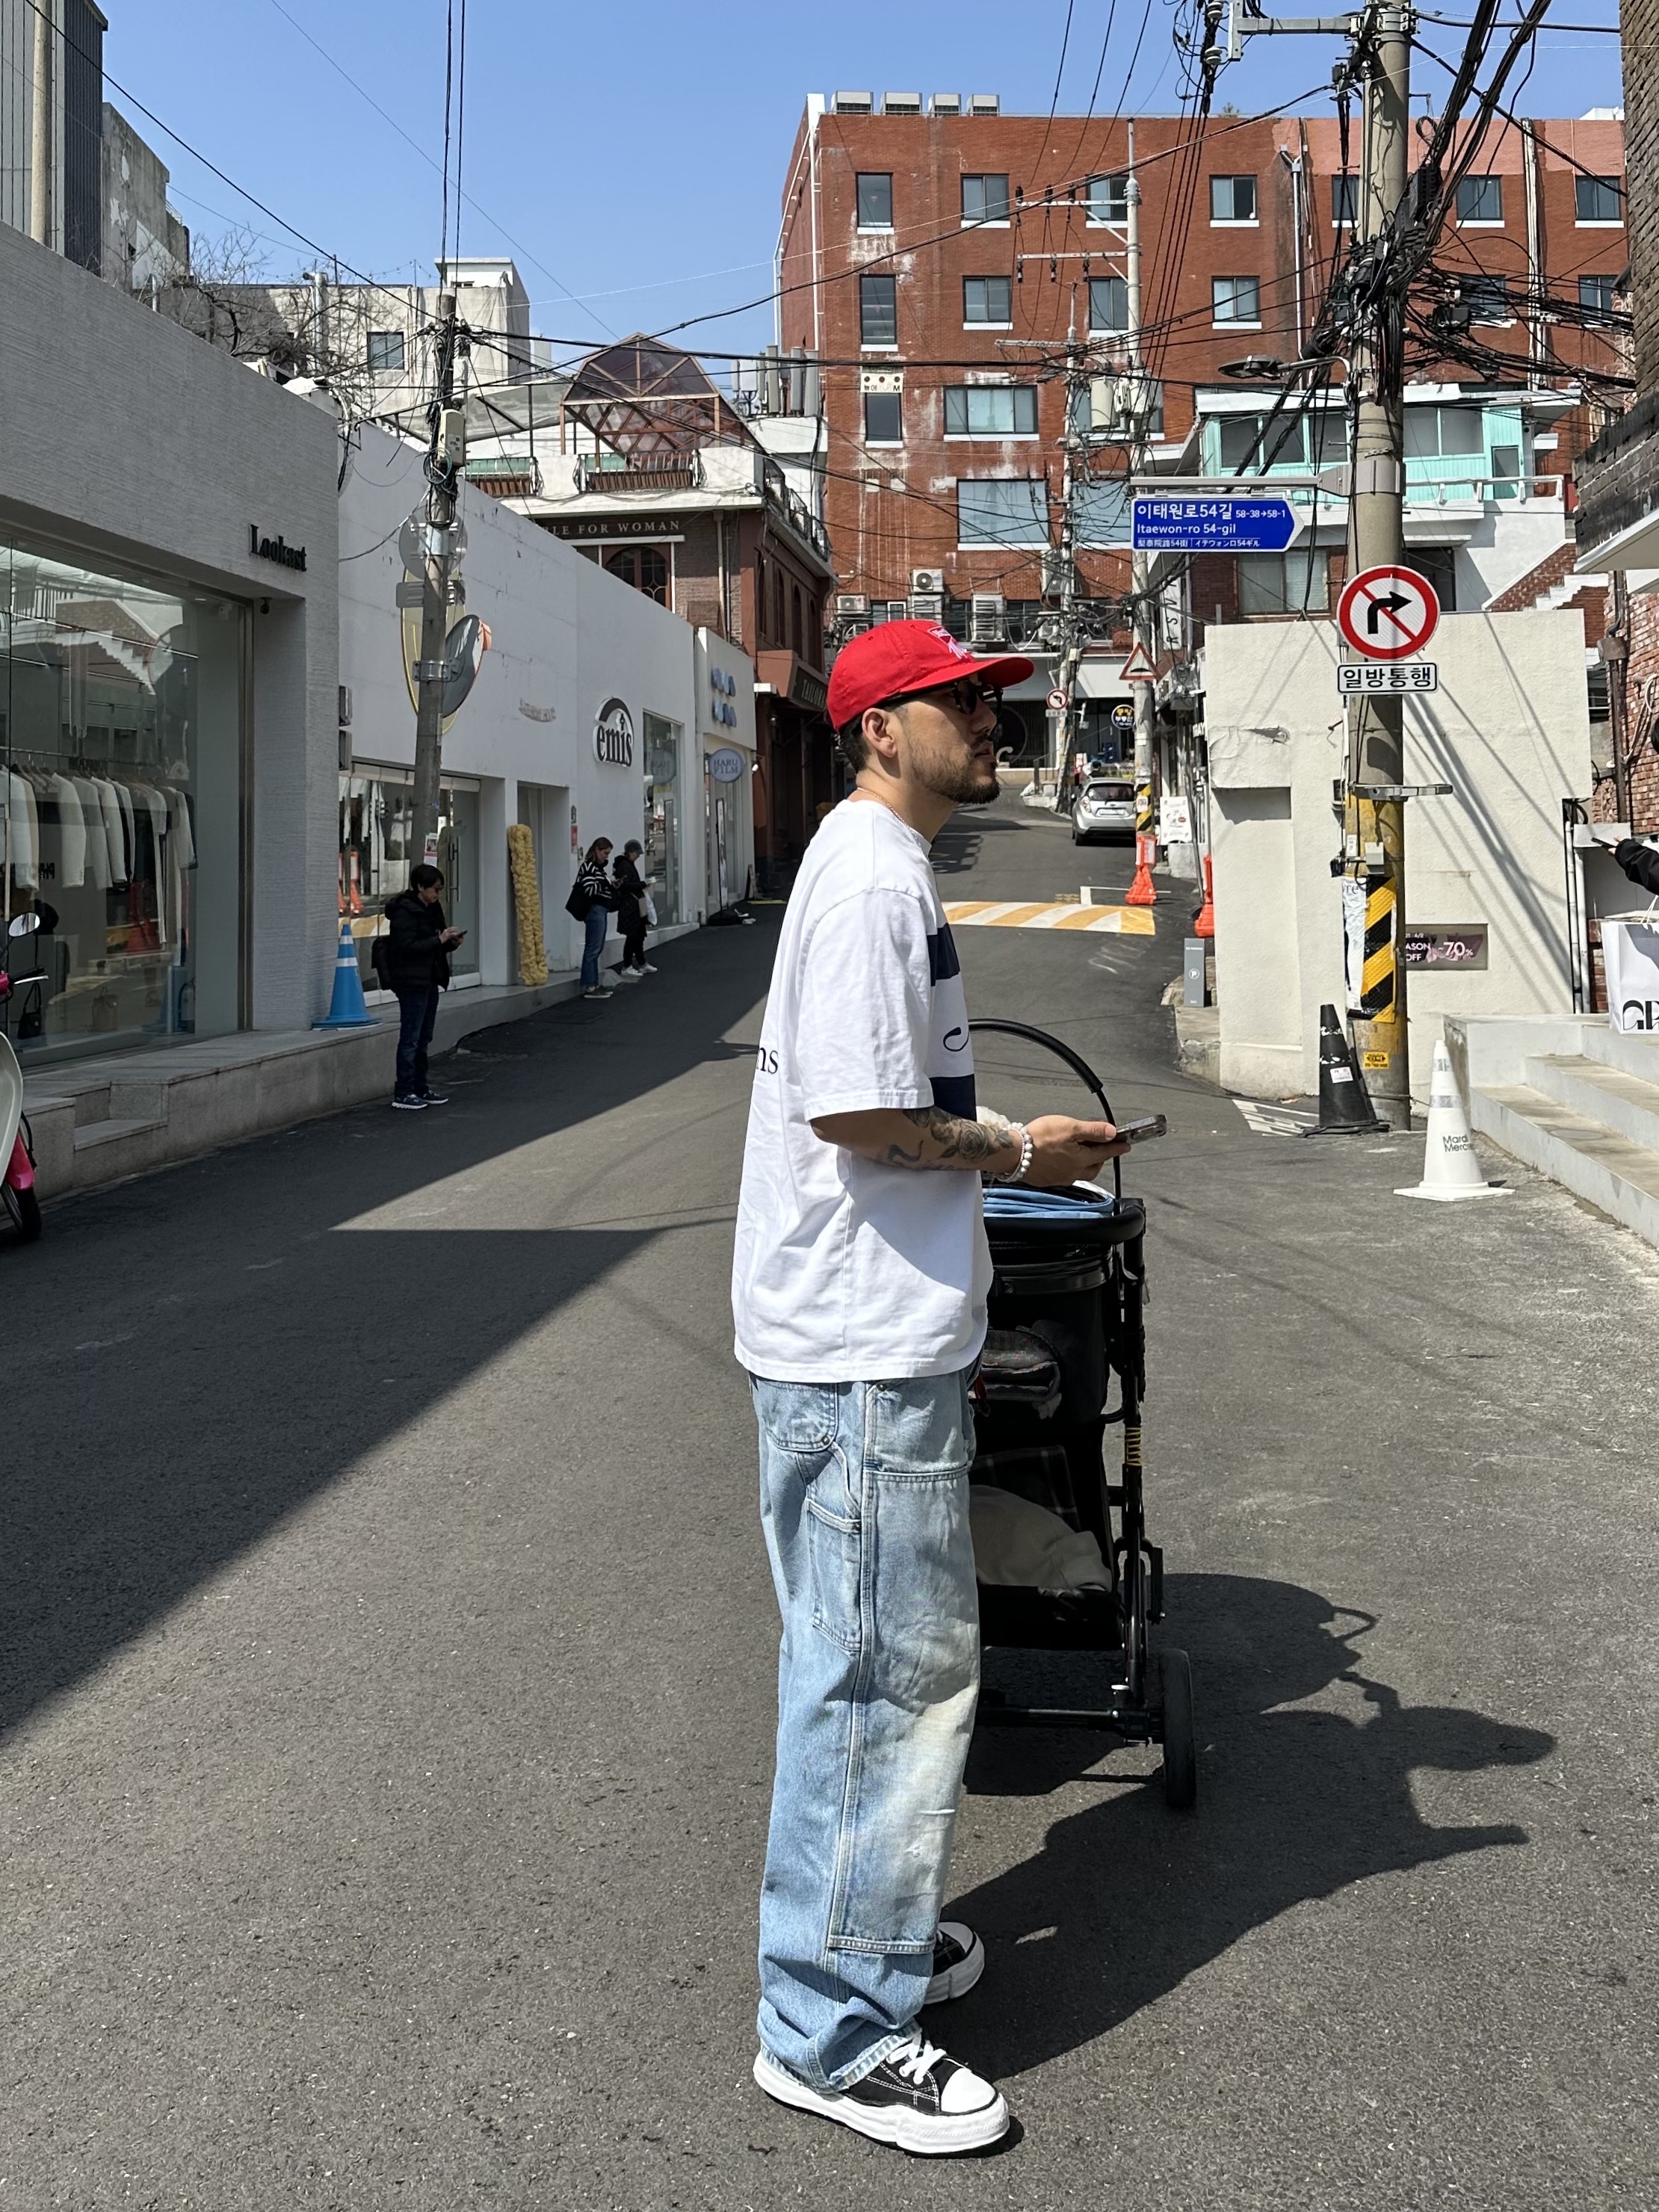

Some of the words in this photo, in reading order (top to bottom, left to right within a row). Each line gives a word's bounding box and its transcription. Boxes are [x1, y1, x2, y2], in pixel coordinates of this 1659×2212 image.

[1137, 503, 1232, 520] 이태원로54길
[578, 524, 609, 534] FOR
[617, 520, 679, 533] WOMAN
[1137, 524, 1200, 534] Itaewon-ro
[1203, 523, 1236, 536] 54-gil
[250, 524, 307, 572] Lookast
[1344, 667, 1431, 688] 일방통행
[597, 719, 633, 767] emis
[714, 759, 738, 767] HARU
[714, 767, 738, 775] FILM
[1406, 942, 1431, 951] ASON
[1406, 954, 1422, 962] OFF
